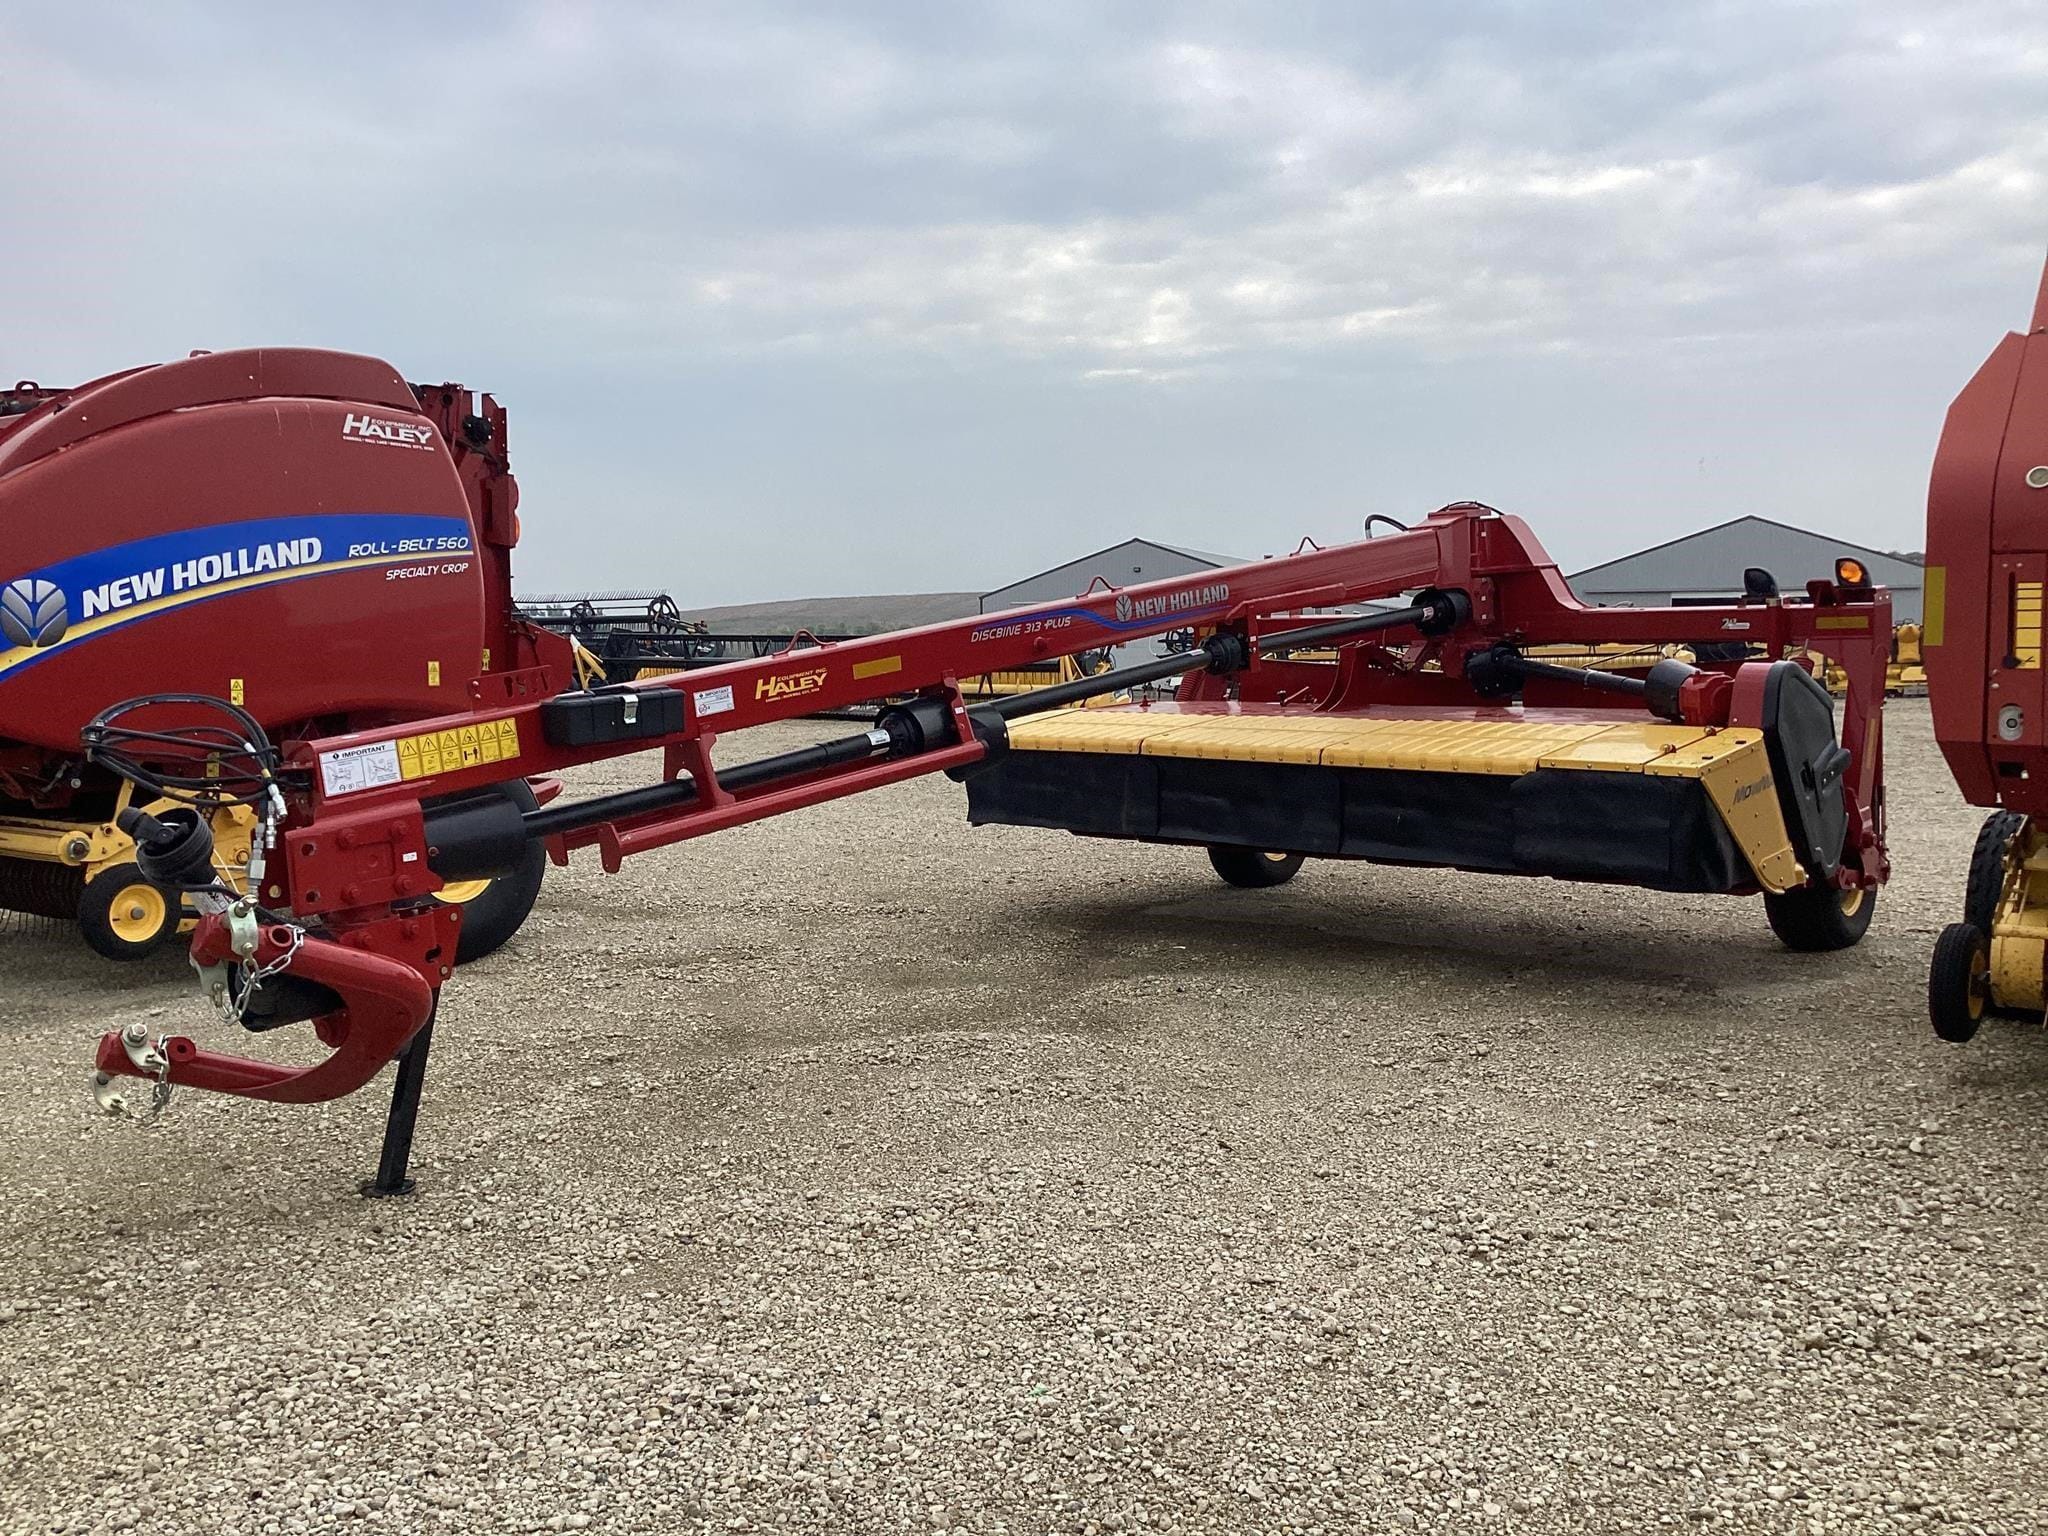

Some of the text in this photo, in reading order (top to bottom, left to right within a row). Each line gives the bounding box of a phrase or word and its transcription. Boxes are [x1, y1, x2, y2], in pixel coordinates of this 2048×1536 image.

[343, 413, 432, 444] HALEY
[371, 419, 416, 429] EQUIPMENT
[348, 537, 469, 558] ROLL-BELT 560
[83, 537, 322, 618] NEW HOLLAND
[386, 563, 469, 580] SPECIALTY CROP
[1135, 583, 1230, 618] NEW HOLLAND
[971, 623, 1022, 643] DISCBINE
[1025, 621, 1041, 634] 313
[755, 672, 828, 700] HALEY
[341, 744, 387, 759] IMPORTANT
